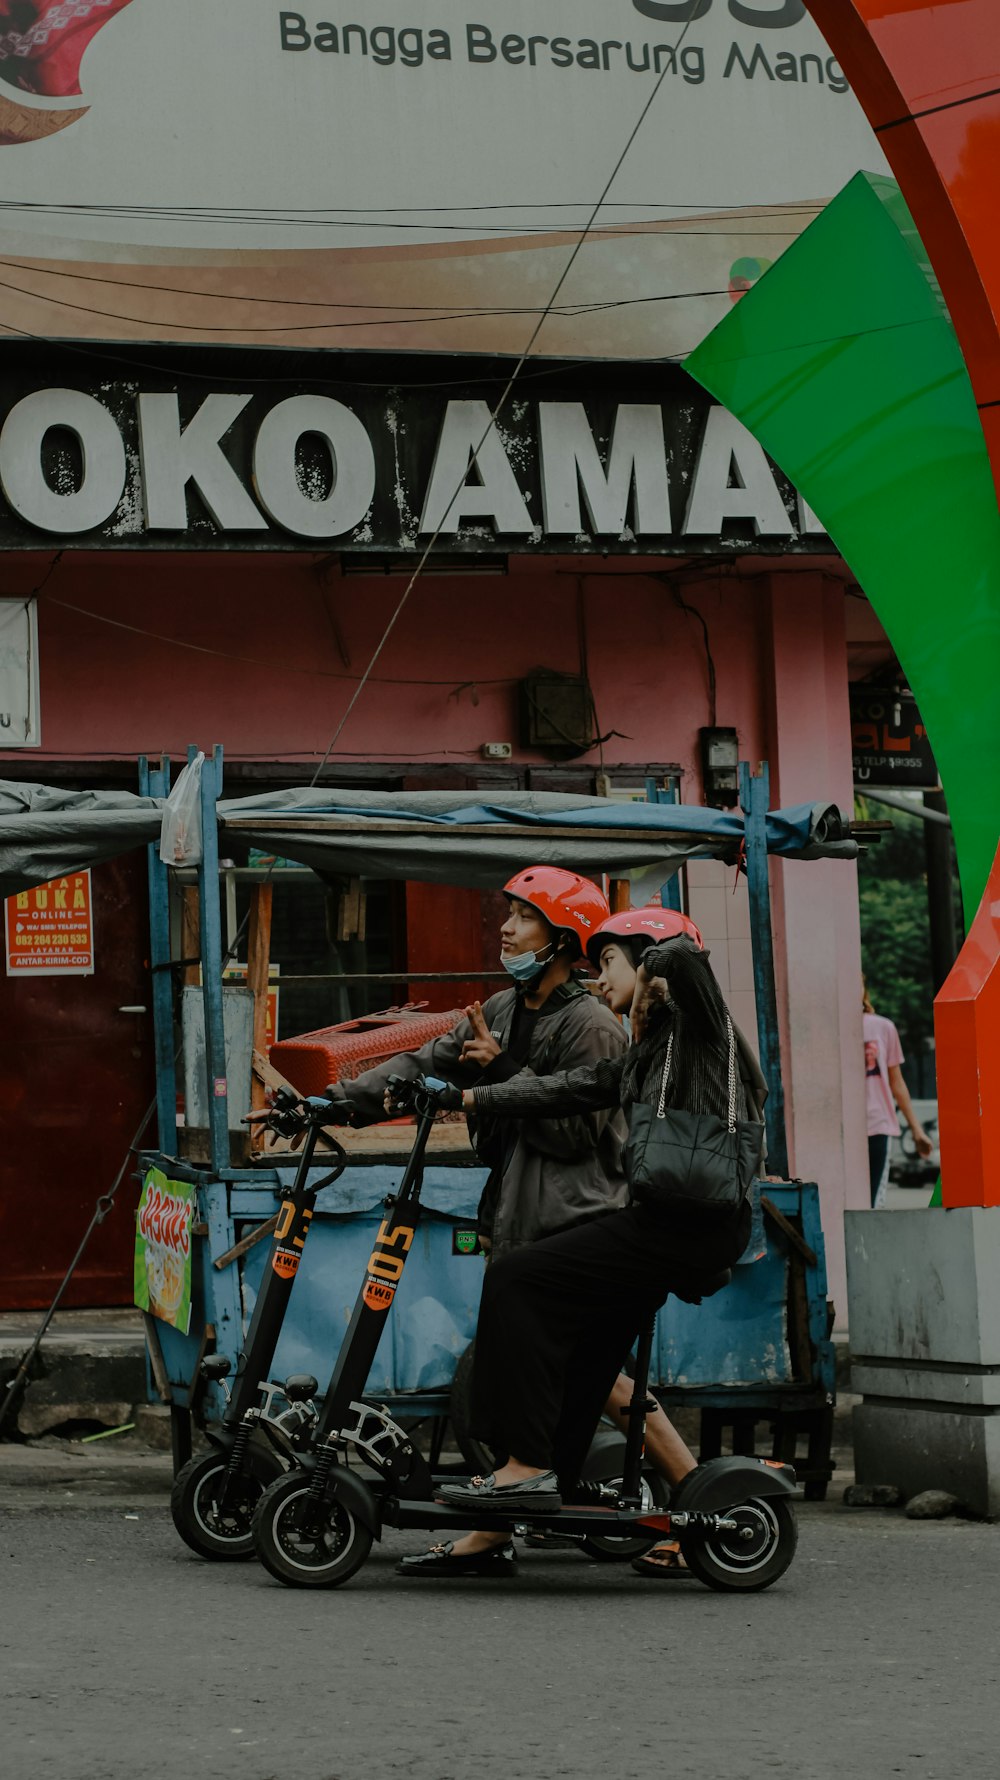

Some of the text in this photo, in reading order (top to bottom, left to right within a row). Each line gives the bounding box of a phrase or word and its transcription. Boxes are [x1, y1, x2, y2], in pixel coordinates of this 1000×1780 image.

[279, 11, 452, 67] Bangga
[466, 23, 705, 85] Bersarung
[0, 388, 828, 538] OKO AMA
[16, 889, 86, 910] BUKA
[31, 911, 73, 920] ONLINE
[57, 922, 88, 931] TELEPON
[275, 1255, 299, 1269] KWB
[366, 1282, 393, 1301] KWB
